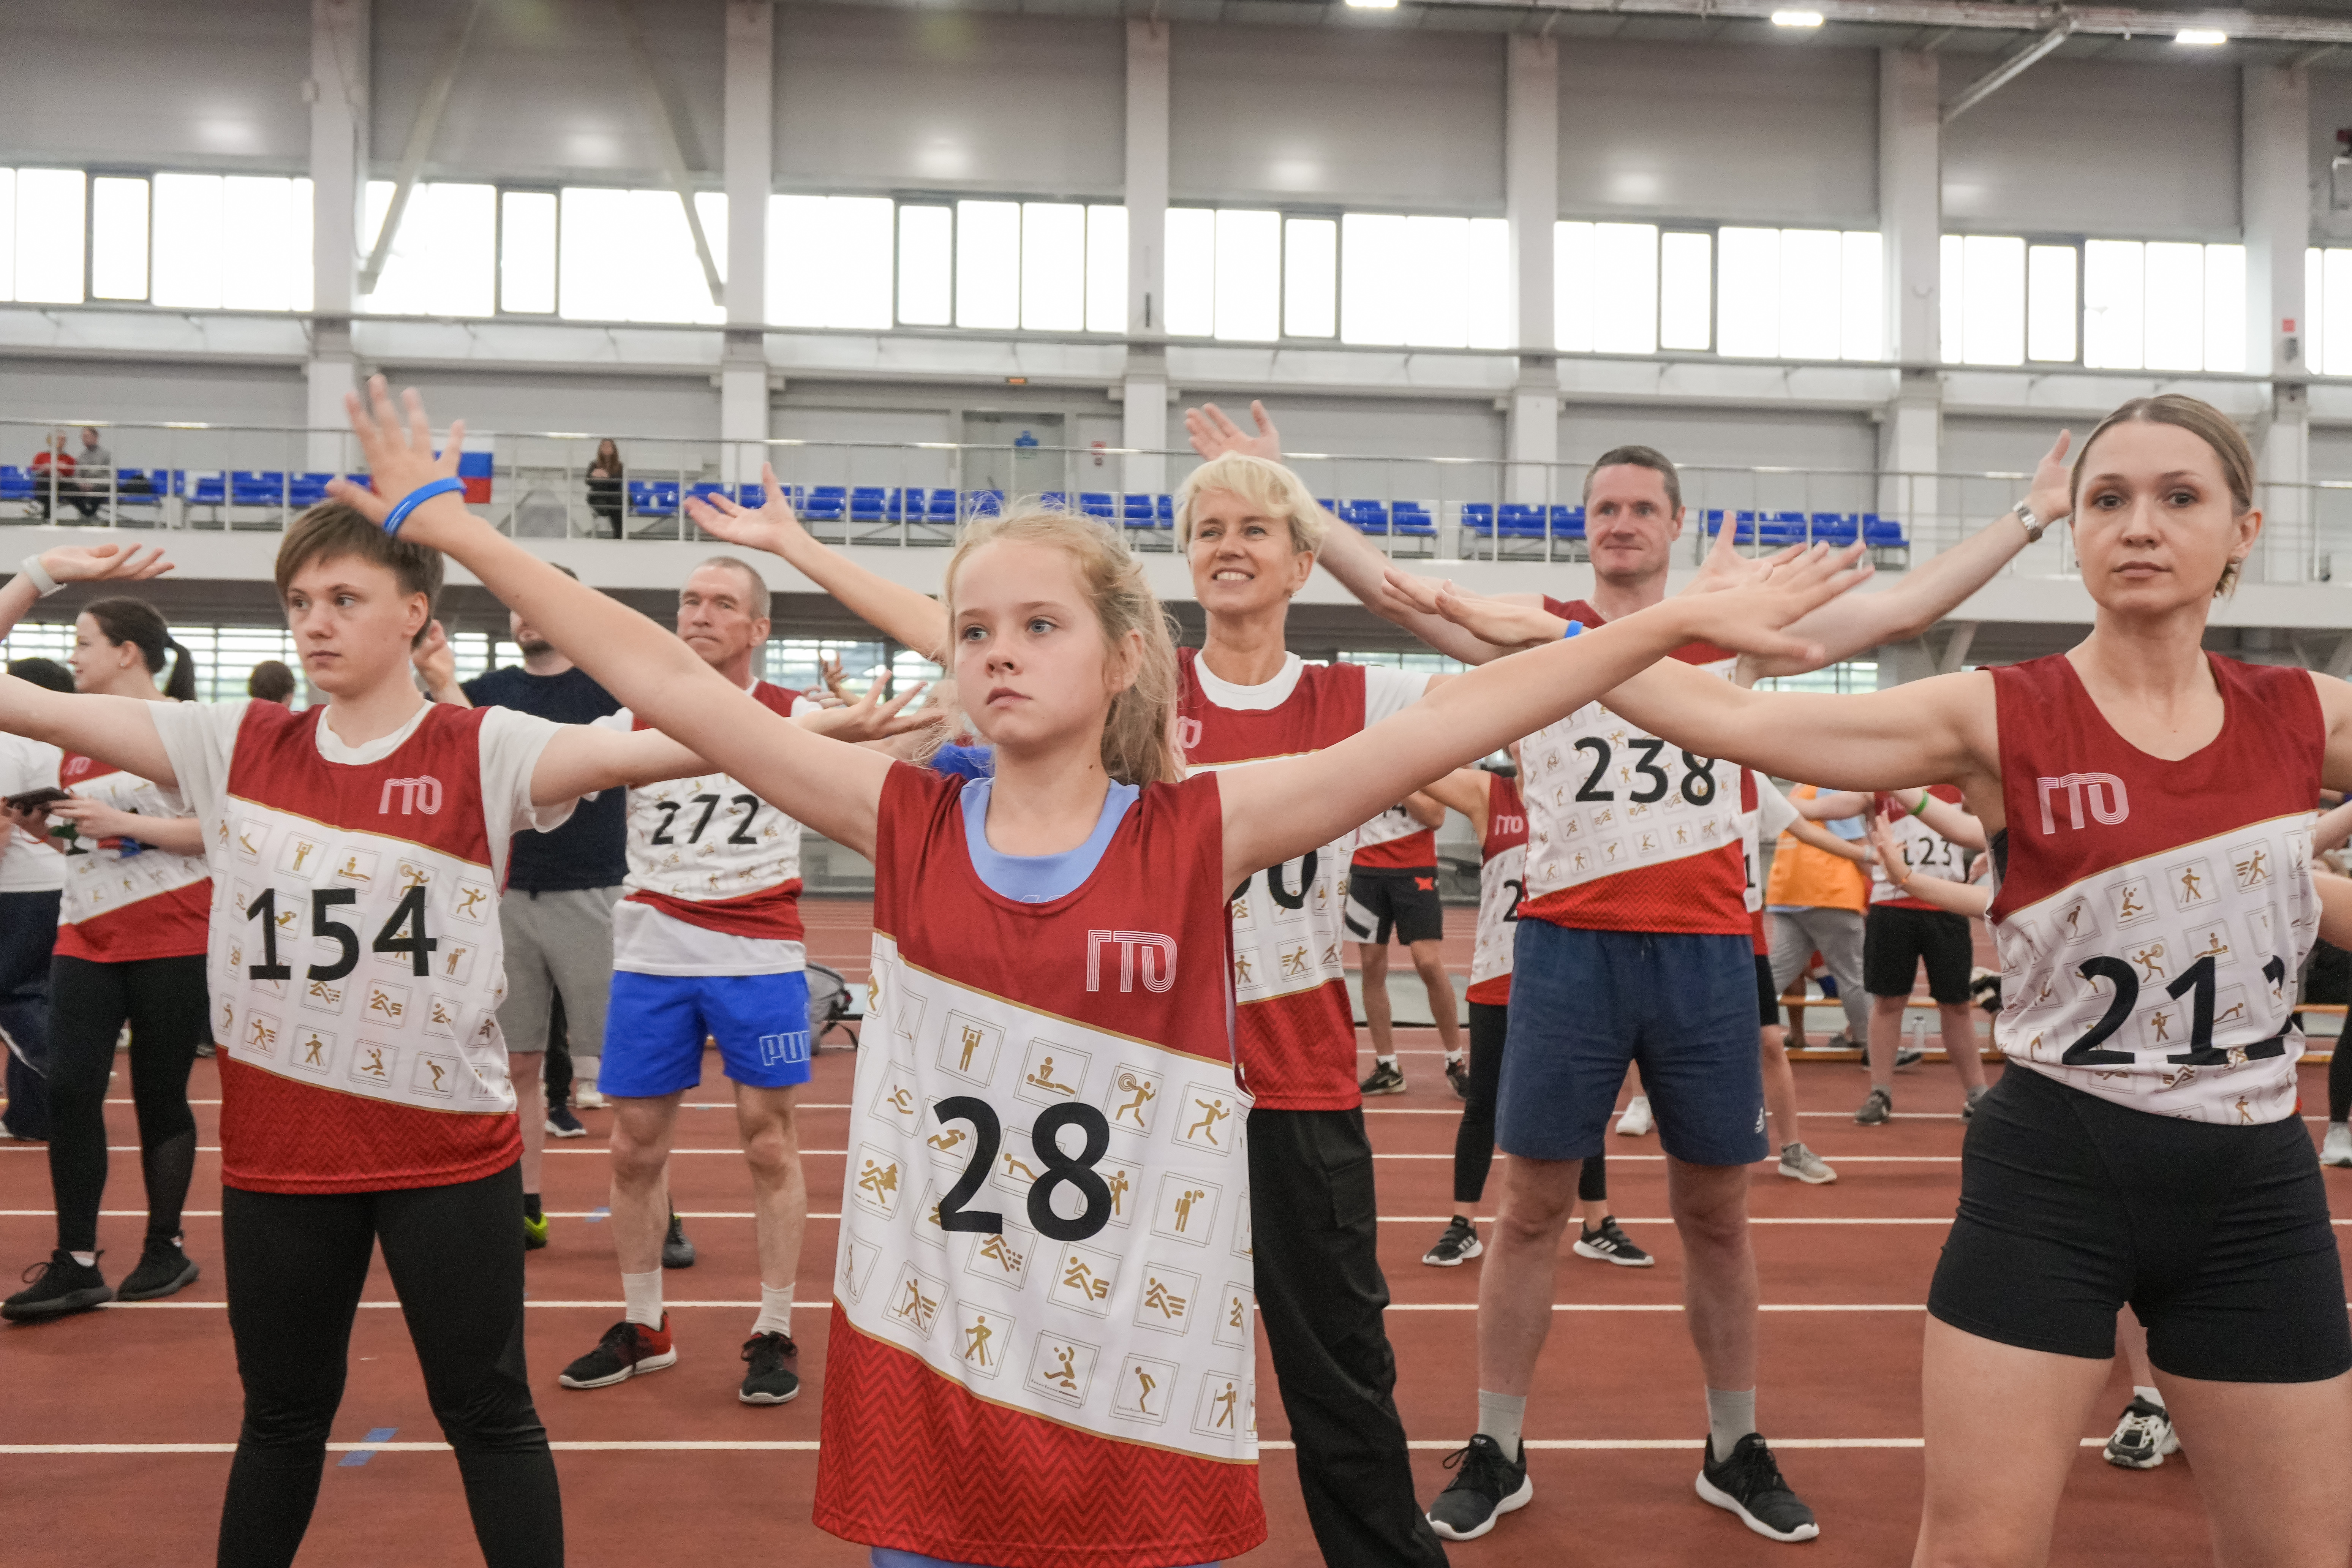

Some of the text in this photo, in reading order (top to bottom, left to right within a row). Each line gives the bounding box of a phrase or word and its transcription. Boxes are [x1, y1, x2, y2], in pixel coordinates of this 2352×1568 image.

[379, 775, 443, 815] ГТО
[1574, 736, 1716, 806] 238
[651, 793, 760, 845] 272
[1494, 814, 1524, 835] ГТО
[2037, 772, 2129, 835] ГТО
[246, 885, 437, 982] 154
[1086, 929, 1178, 993] ГТО
[933, 1096, 1112, 1241] 28
